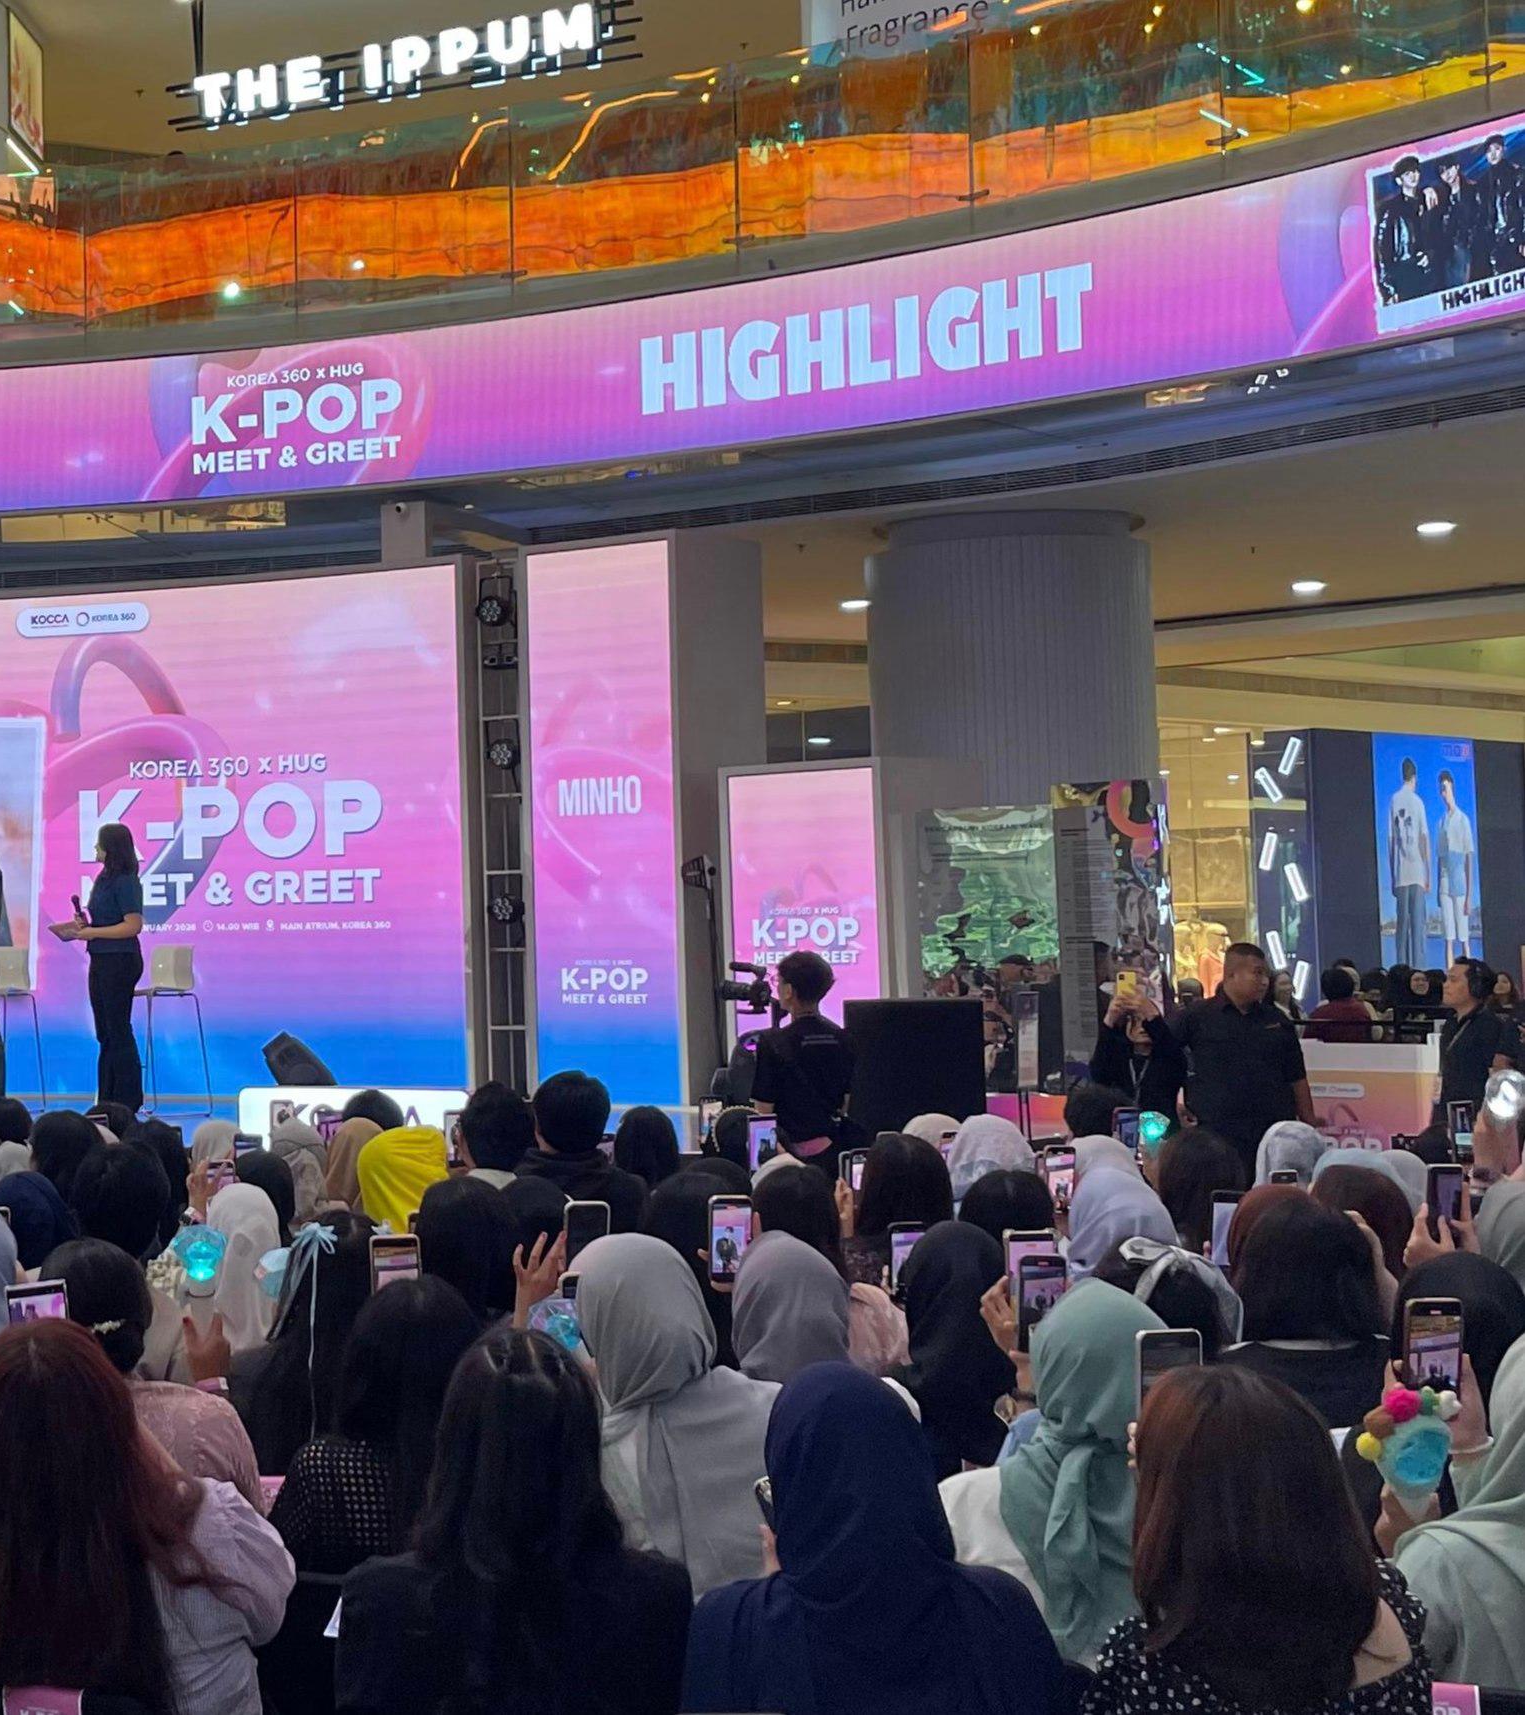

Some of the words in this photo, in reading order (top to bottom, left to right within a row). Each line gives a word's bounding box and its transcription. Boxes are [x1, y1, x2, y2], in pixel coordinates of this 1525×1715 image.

[194, 56, 322, 119] THE
[363, 3, 594, 89] IPPUM
[639, 262, 1092, 415] HIGHLIGHT
[227, 373, 277, 388] KOREA
[281, 369, 311, 383] 360
[329, 362, 364, 377] HUG
[191, 378, 402, 445] K-POP
[193, 448, 271, 475] MEET
[278, 445, 298, 468] &
[305, 435, 401, 465] GREET
[31, 614, 69, 625] KOCCA
[129, 761, 204, 778] KOREA
[208, 757, 249, 776] 360
[278, 753, 326, 772] HUG
[558, 775, 642, 817] MINHO
[78, 780, 383, 862] K-POP
[205, 872, 233, 905] &
[244, 868, 381, 905] GREET
[342, 920, 372, 929] KOREA
[752, 917, 859, 947] K-POP
[561, 967, 648, 991] K-POP
[562, 993, 594, 1004] MEET
[597, 993, 606, 1004] &
[609, 993, 648, 1004] GREET
